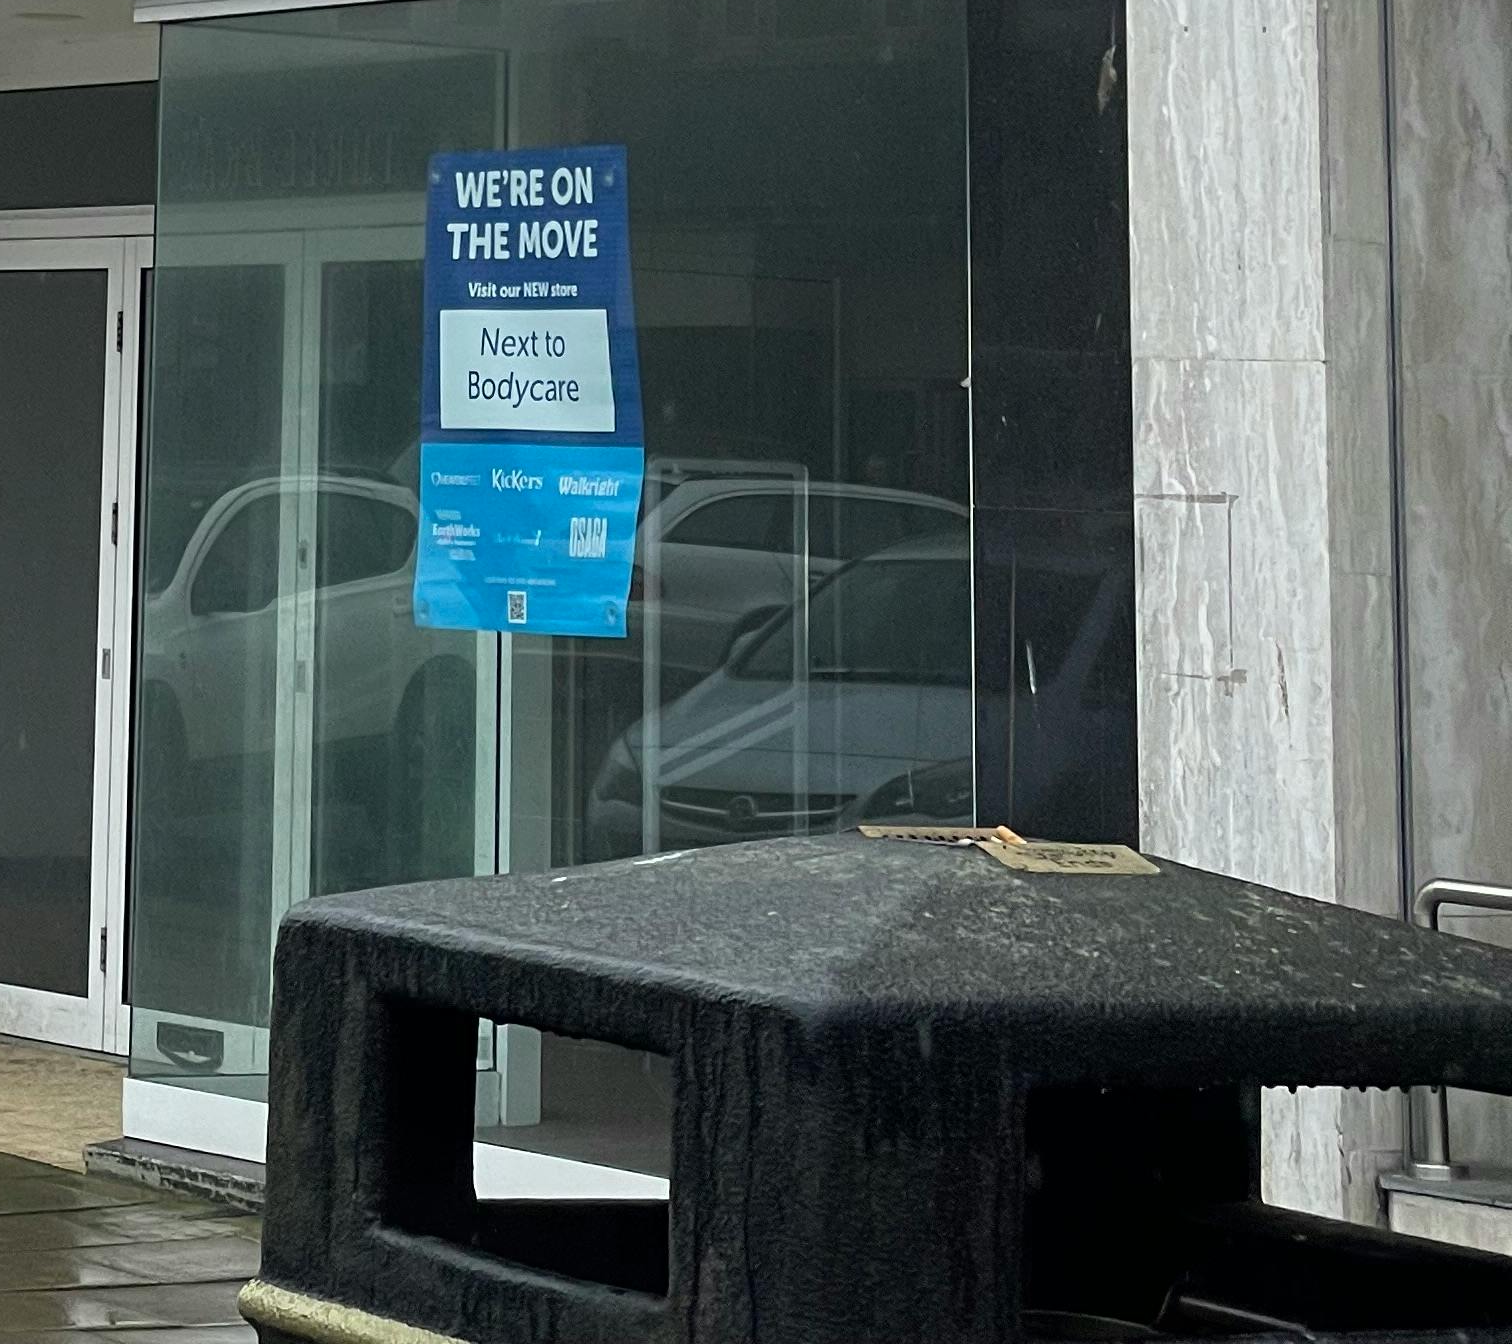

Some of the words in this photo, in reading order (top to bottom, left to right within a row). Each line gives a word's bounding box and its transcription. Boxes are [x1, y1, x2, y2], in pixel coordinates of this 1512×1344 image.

[455, 169, 544, 209] WE'RE
[551, 166, 593, 206] ON
[447, 222, 510, 260] THE
[518, 219, 598, 259] MOVE
[468, 282, 497, 297] Visit
[500, 284, 521, 297] our
[523, 282, 549, 297] NEW
[551, 282, 578, 297] store
[481, 327, 538, 357] Next
[545, 330, 566, 357] to
[468, 370, 580, 408] Bodycare
[559, 476, 620, 497] Walkright
